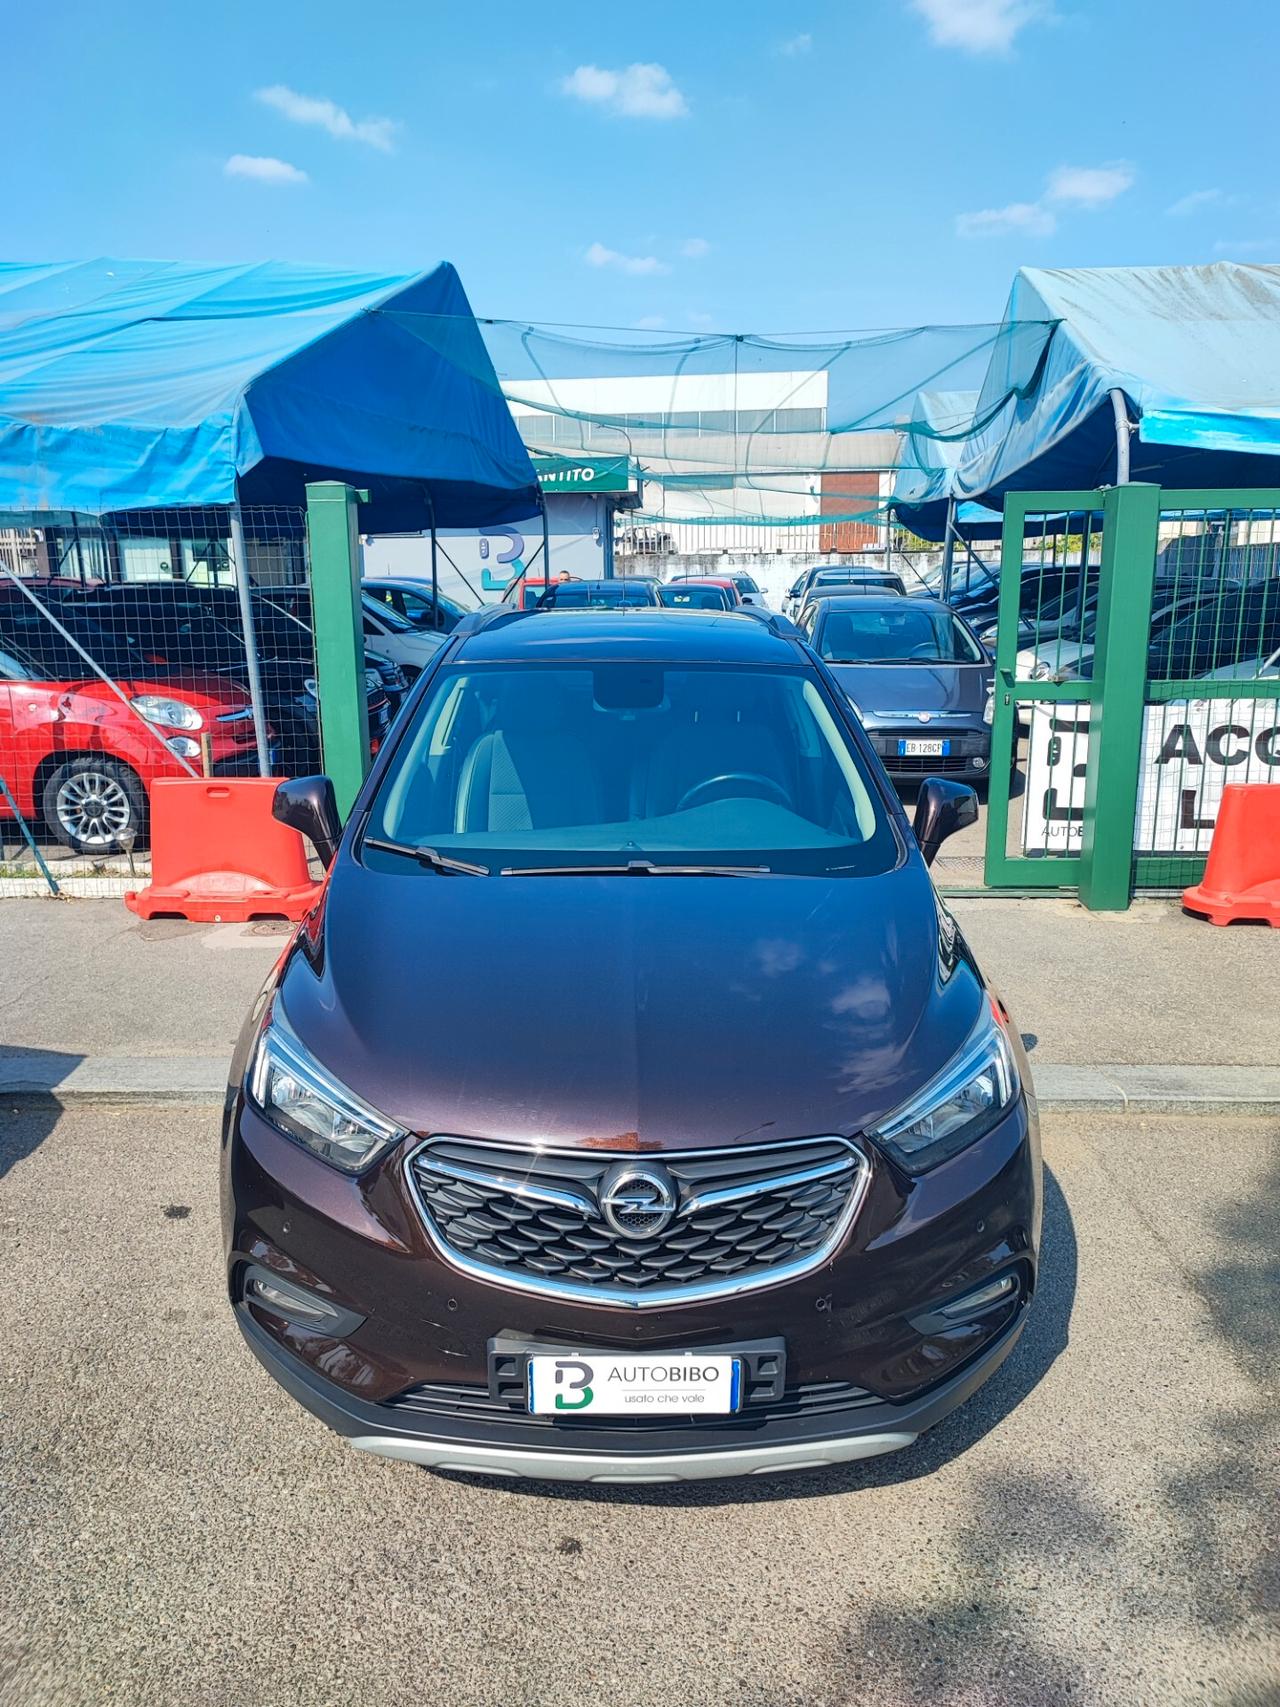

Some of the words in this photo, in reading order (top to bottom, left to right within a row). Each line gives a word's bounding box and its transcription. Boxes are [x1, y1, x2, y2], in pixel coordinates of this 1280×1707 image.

[608, 1366, 720, 1382] AUTOBIBO
[624, 1393, 655, 1404] usato
[657, 1393, 679, 1404] che
[682, 1393, 705, 1403] vale
